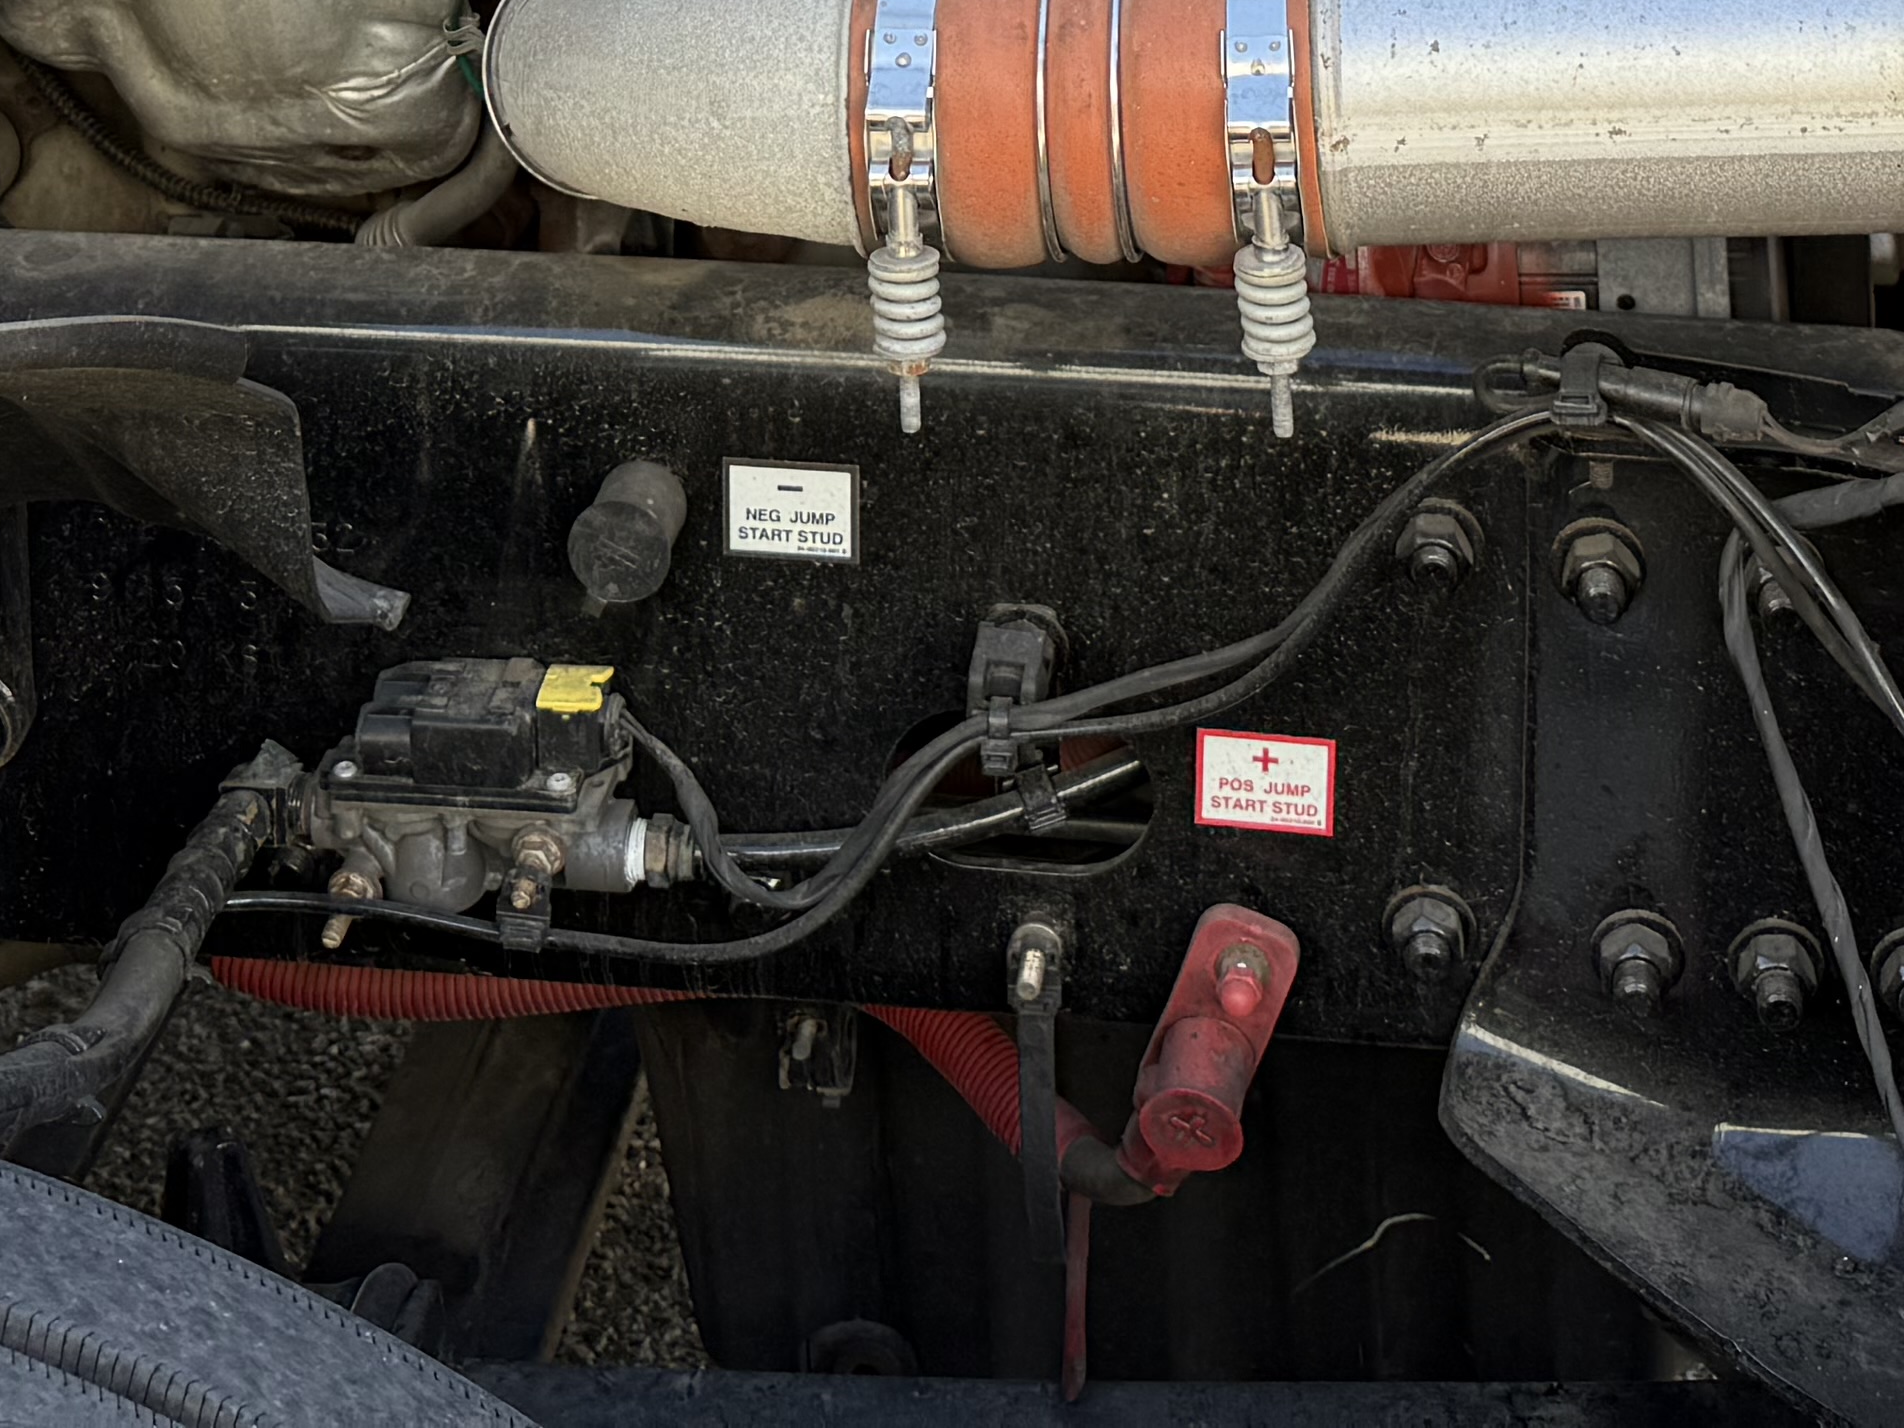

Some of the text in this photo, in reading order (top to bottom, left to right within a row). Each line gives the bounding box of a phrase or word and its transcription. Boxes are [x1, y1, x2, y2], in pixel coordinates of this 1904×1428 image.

[746, 507, 836, 526] NEG JUMP
[738, 526, 844, 546] START STUD
[1218, 777, 1311, 797] POS JUMP
[1211, 795, 1318, 817] START STUD
